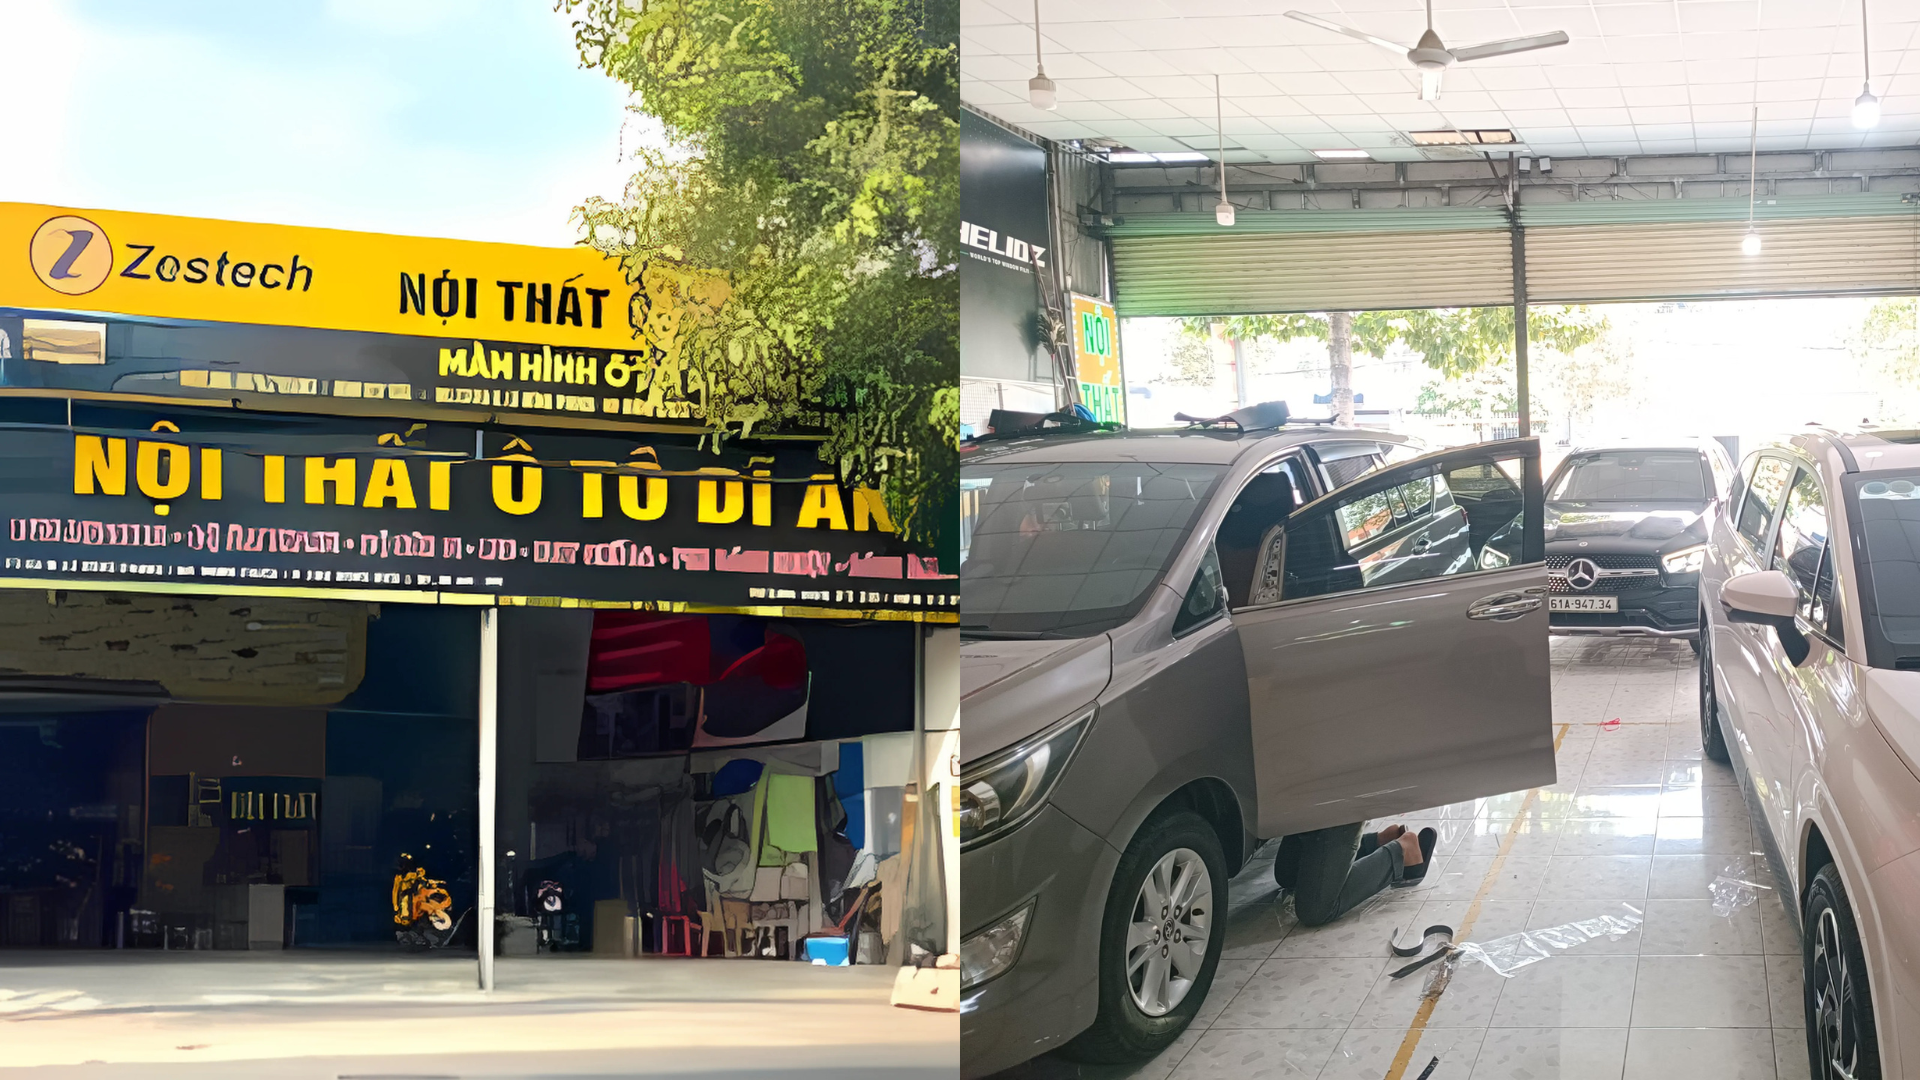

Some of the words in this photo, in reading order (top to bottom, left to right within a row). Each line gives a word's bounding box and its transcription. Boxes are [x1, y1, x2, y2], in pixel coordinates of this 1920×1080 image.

[119, 243, 313, 292] Zostech
[991, 257, 1002, 266] TOP
[1001, 260, 1020, 272] WINDOW
[1019, 266, 1030, 274] FILM
[1082, 304, 1112, 366] NỘI
[73, 420, 223, 516] NỘI
[1550, 599, 1612, 610] 61A-947.34
